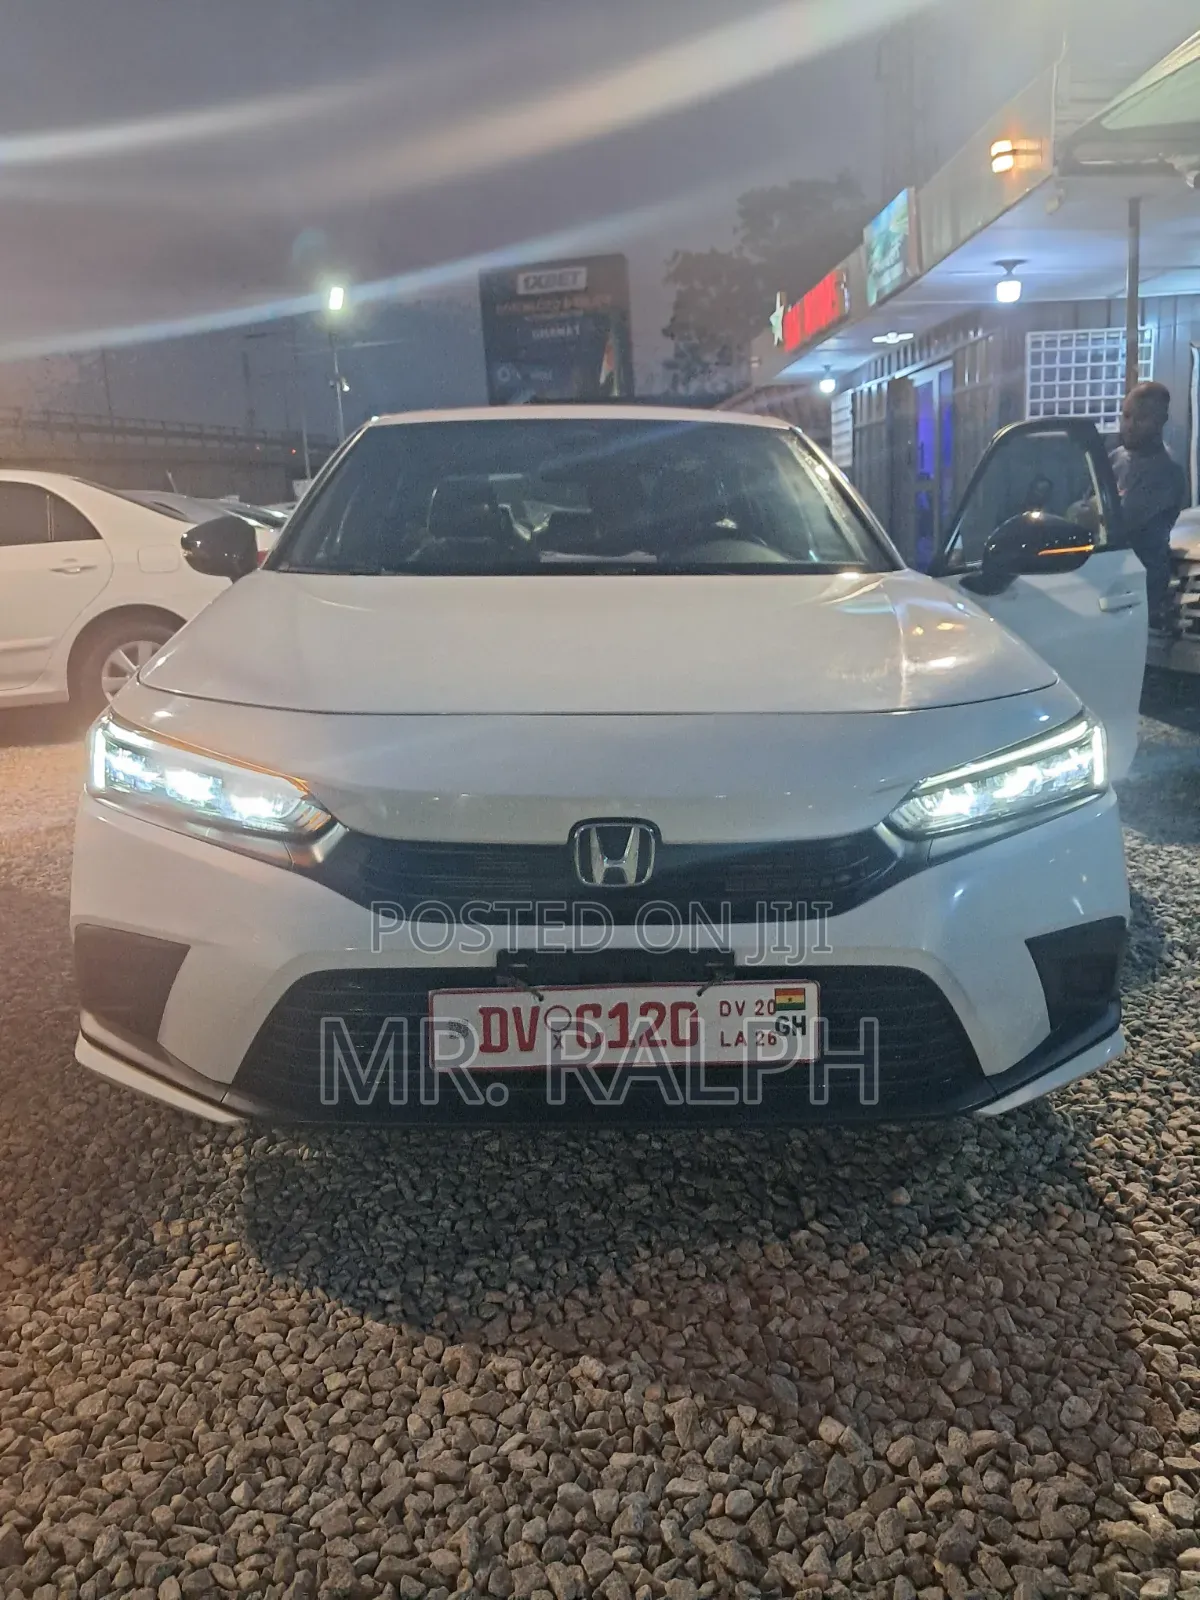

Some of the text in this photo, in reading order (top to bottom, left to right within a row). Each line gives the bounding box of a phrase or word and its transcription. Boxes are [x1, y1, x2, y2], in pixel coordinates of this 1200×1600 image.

[719, 998, 777, 1017] DV 20
[478, 1005, 541, 1053] DV
[775, 1015, 807, 1036] GH
[720, 1030, 777, 1047] LA 26
